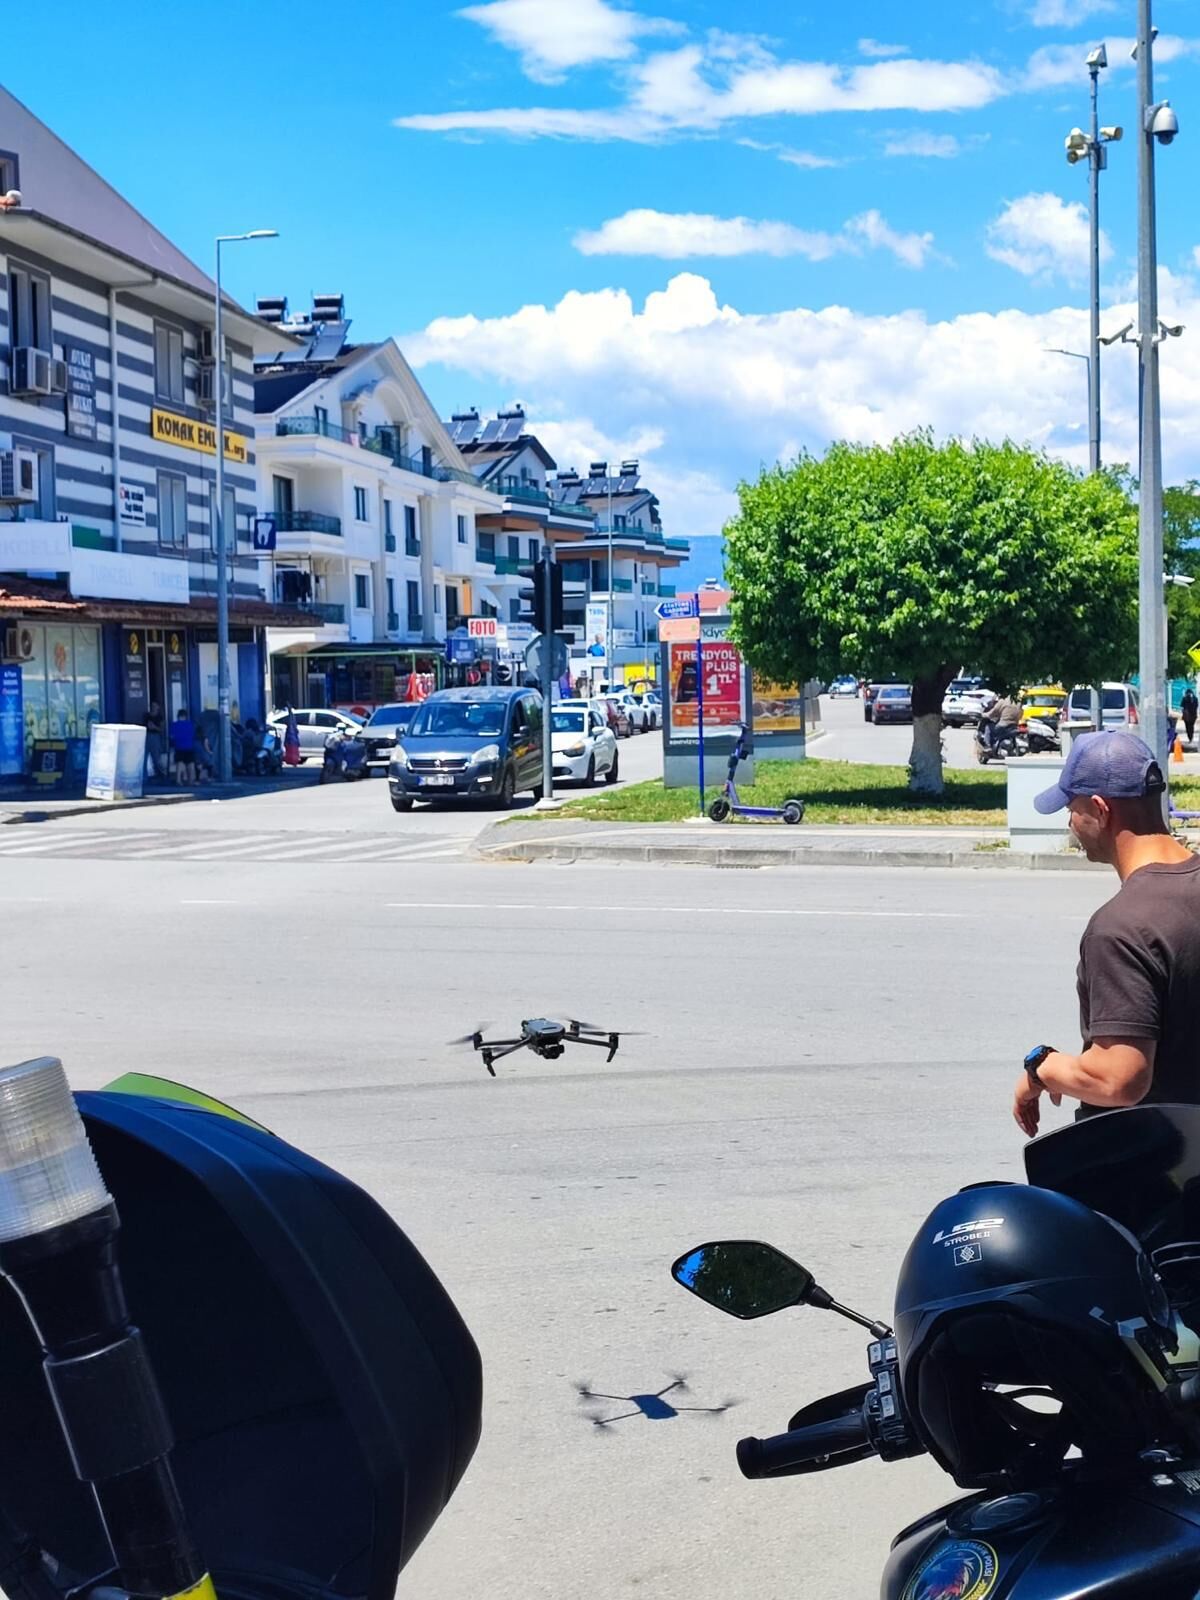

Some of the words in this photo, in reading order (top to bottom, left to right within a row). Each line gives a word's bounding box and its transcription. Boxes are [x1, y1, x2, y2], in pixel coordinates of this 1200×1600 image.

[157, 415, 194, 443] KONAK
[198, 427, 245, 460] EMLK.org
[470, 621, 495, 635] FOTO
[675, 650, 736, 661] TRENDYOL
[705, 661, 736, 672] PLUS
[706, 674, 721, 696] 1
[932, 1217, 1005, 1244] LS2
[944, 1232, 982, 1247] STROBE
